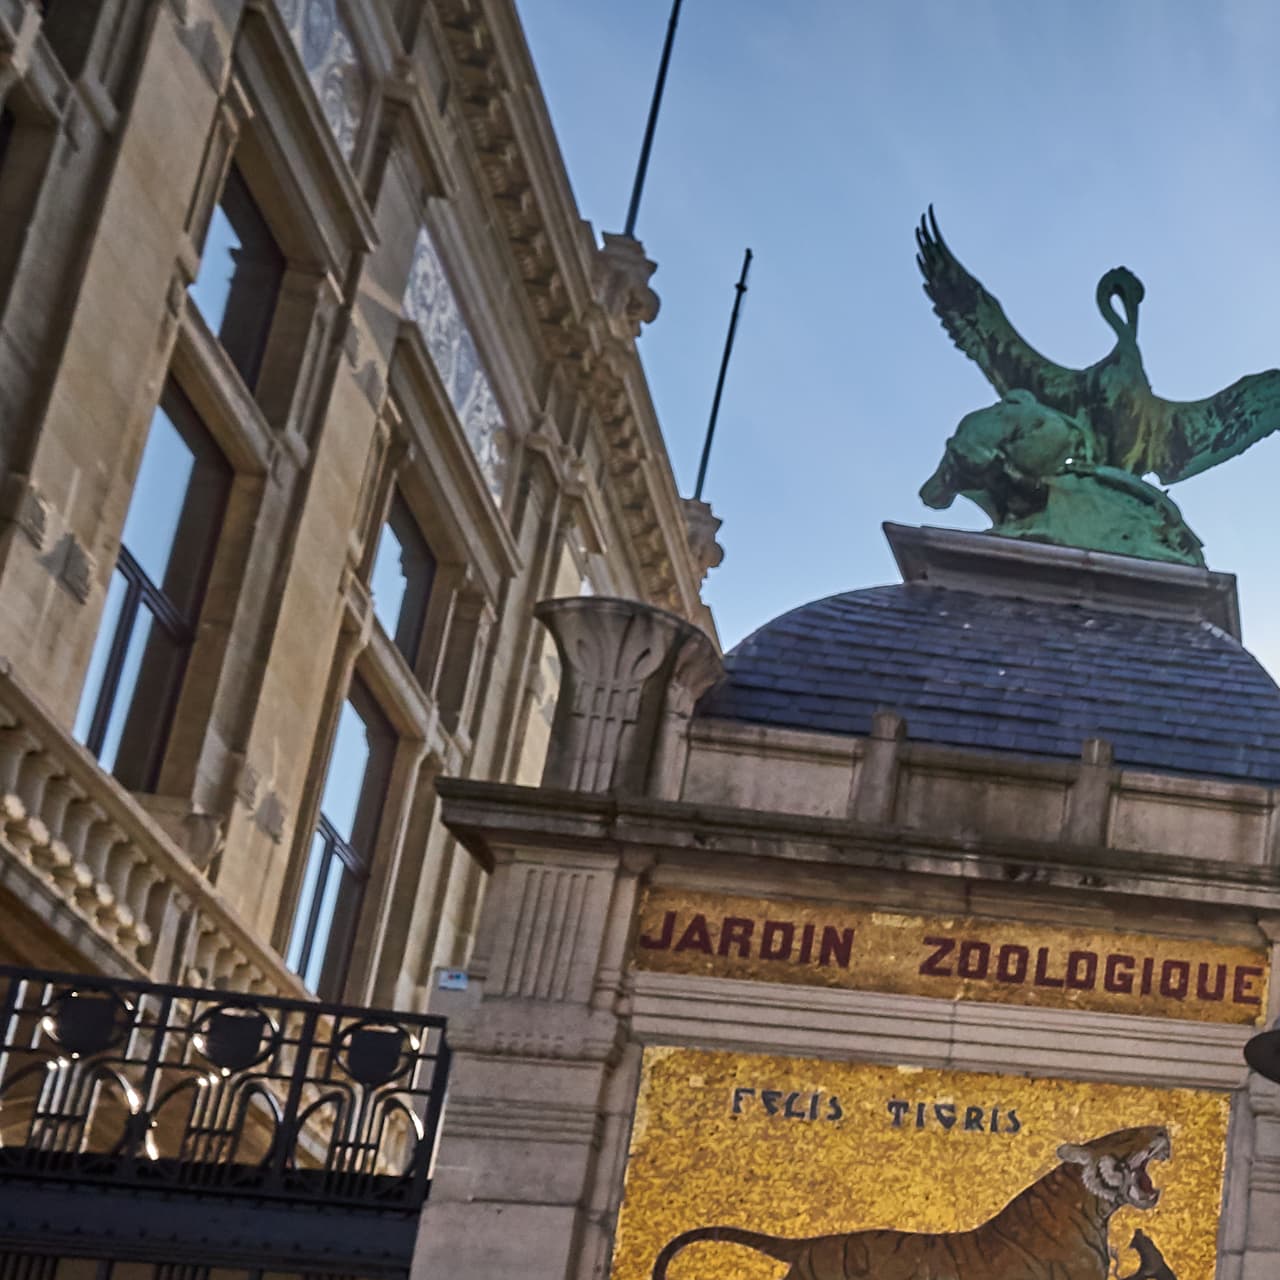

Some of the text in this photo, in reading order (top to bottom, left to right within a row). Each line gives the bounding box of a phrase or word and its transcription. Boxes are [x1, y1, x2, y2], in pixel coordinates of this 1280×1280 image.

[639, 910, 1265, 1006] JARDIN ZOOLOGIQUE
[732, 1087, 1021, 1134] FELIS TIGRIS
